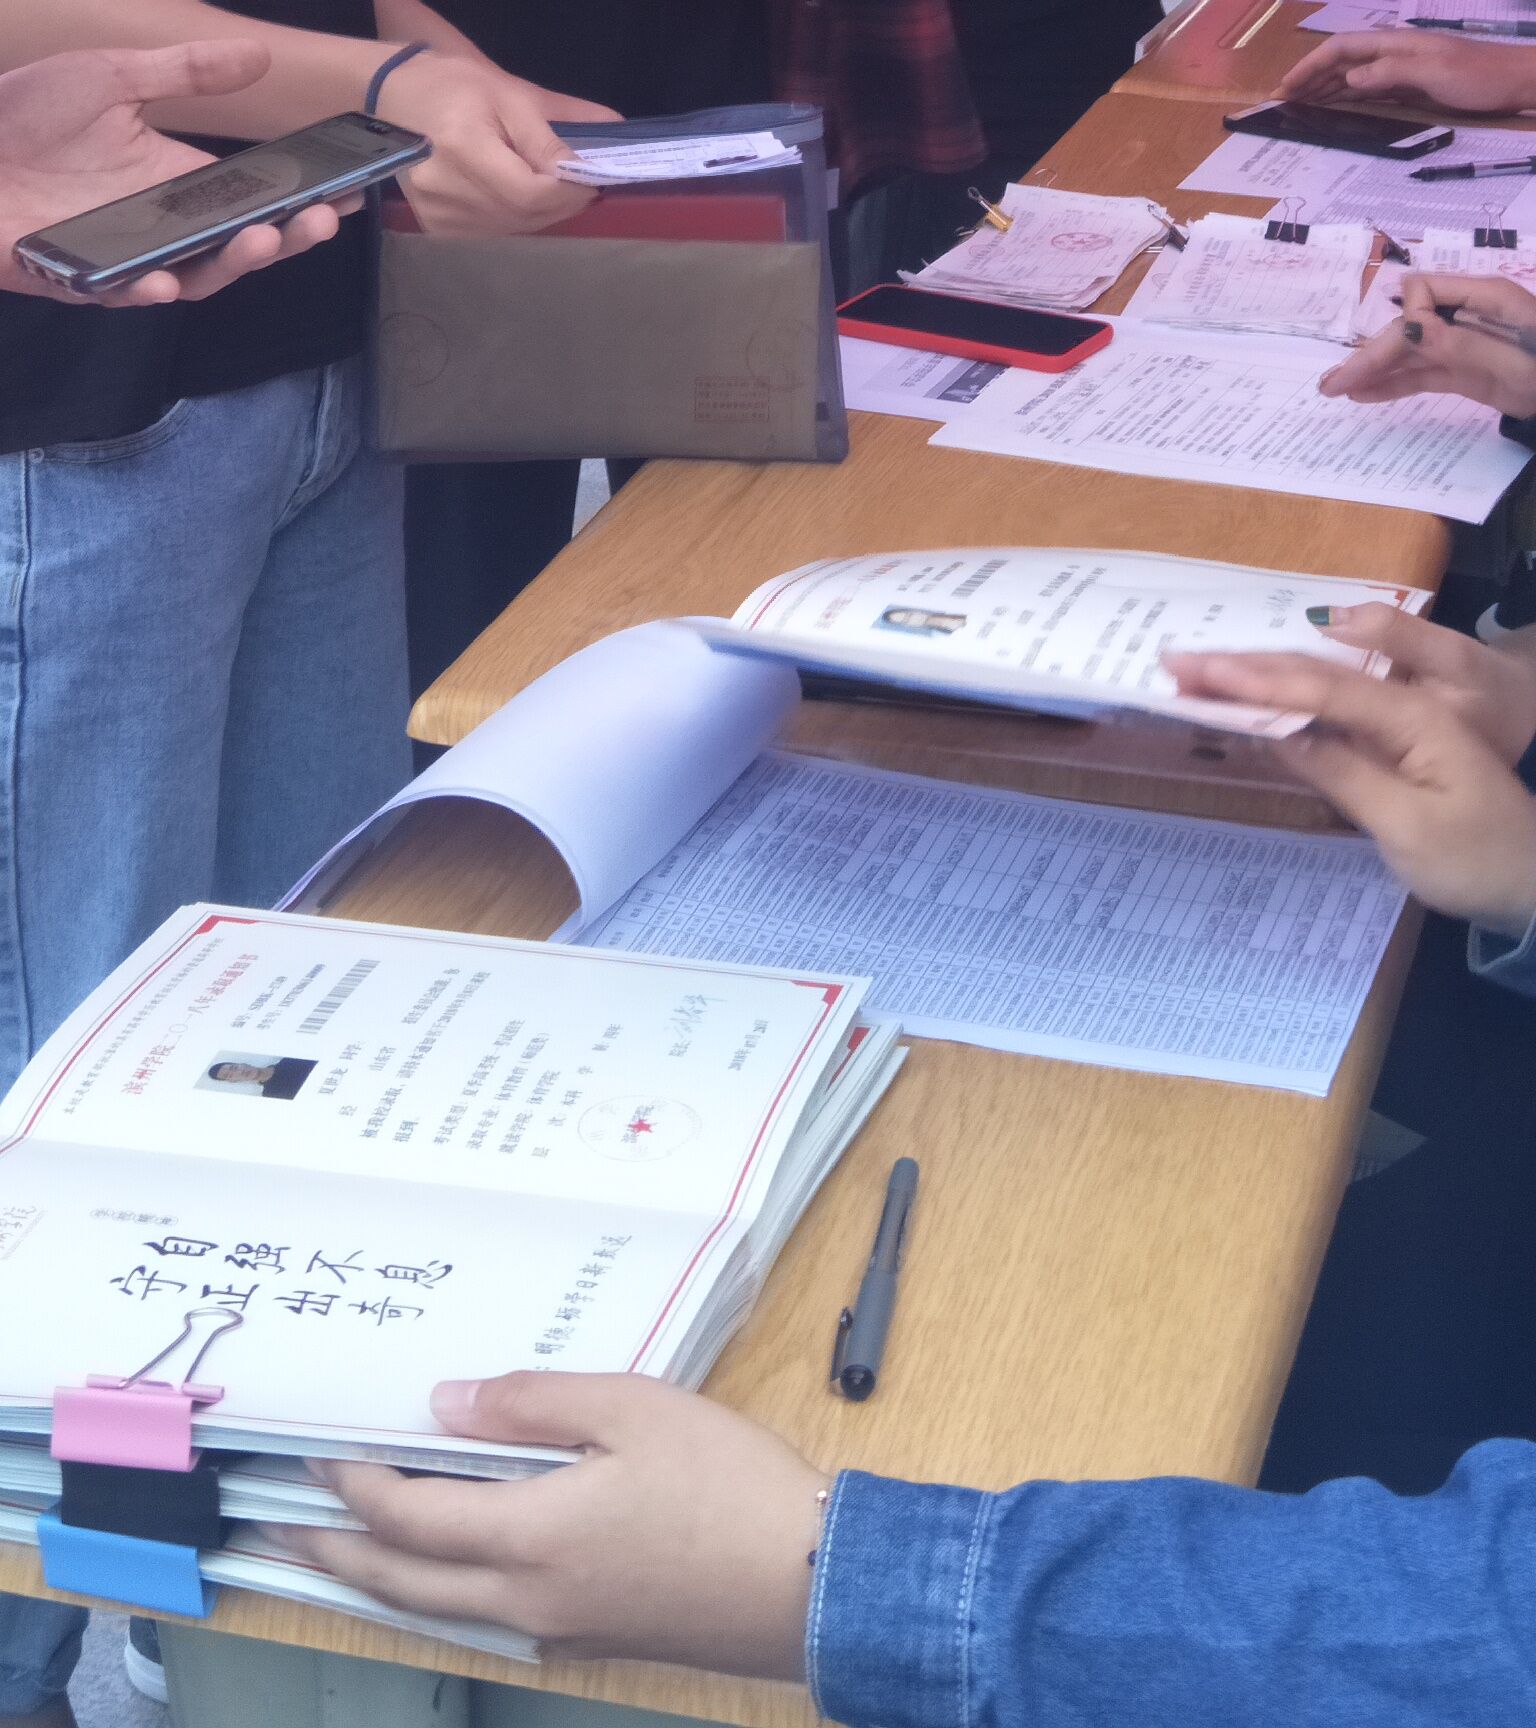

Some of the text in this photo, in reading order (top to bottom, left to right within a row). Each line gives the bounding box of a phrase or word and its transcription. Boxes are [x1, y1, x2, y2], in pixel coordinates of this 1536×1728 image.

[143, 1235, 454, 1289] 自强不息
[109, 1265, 425, 1327] 守正出奇
